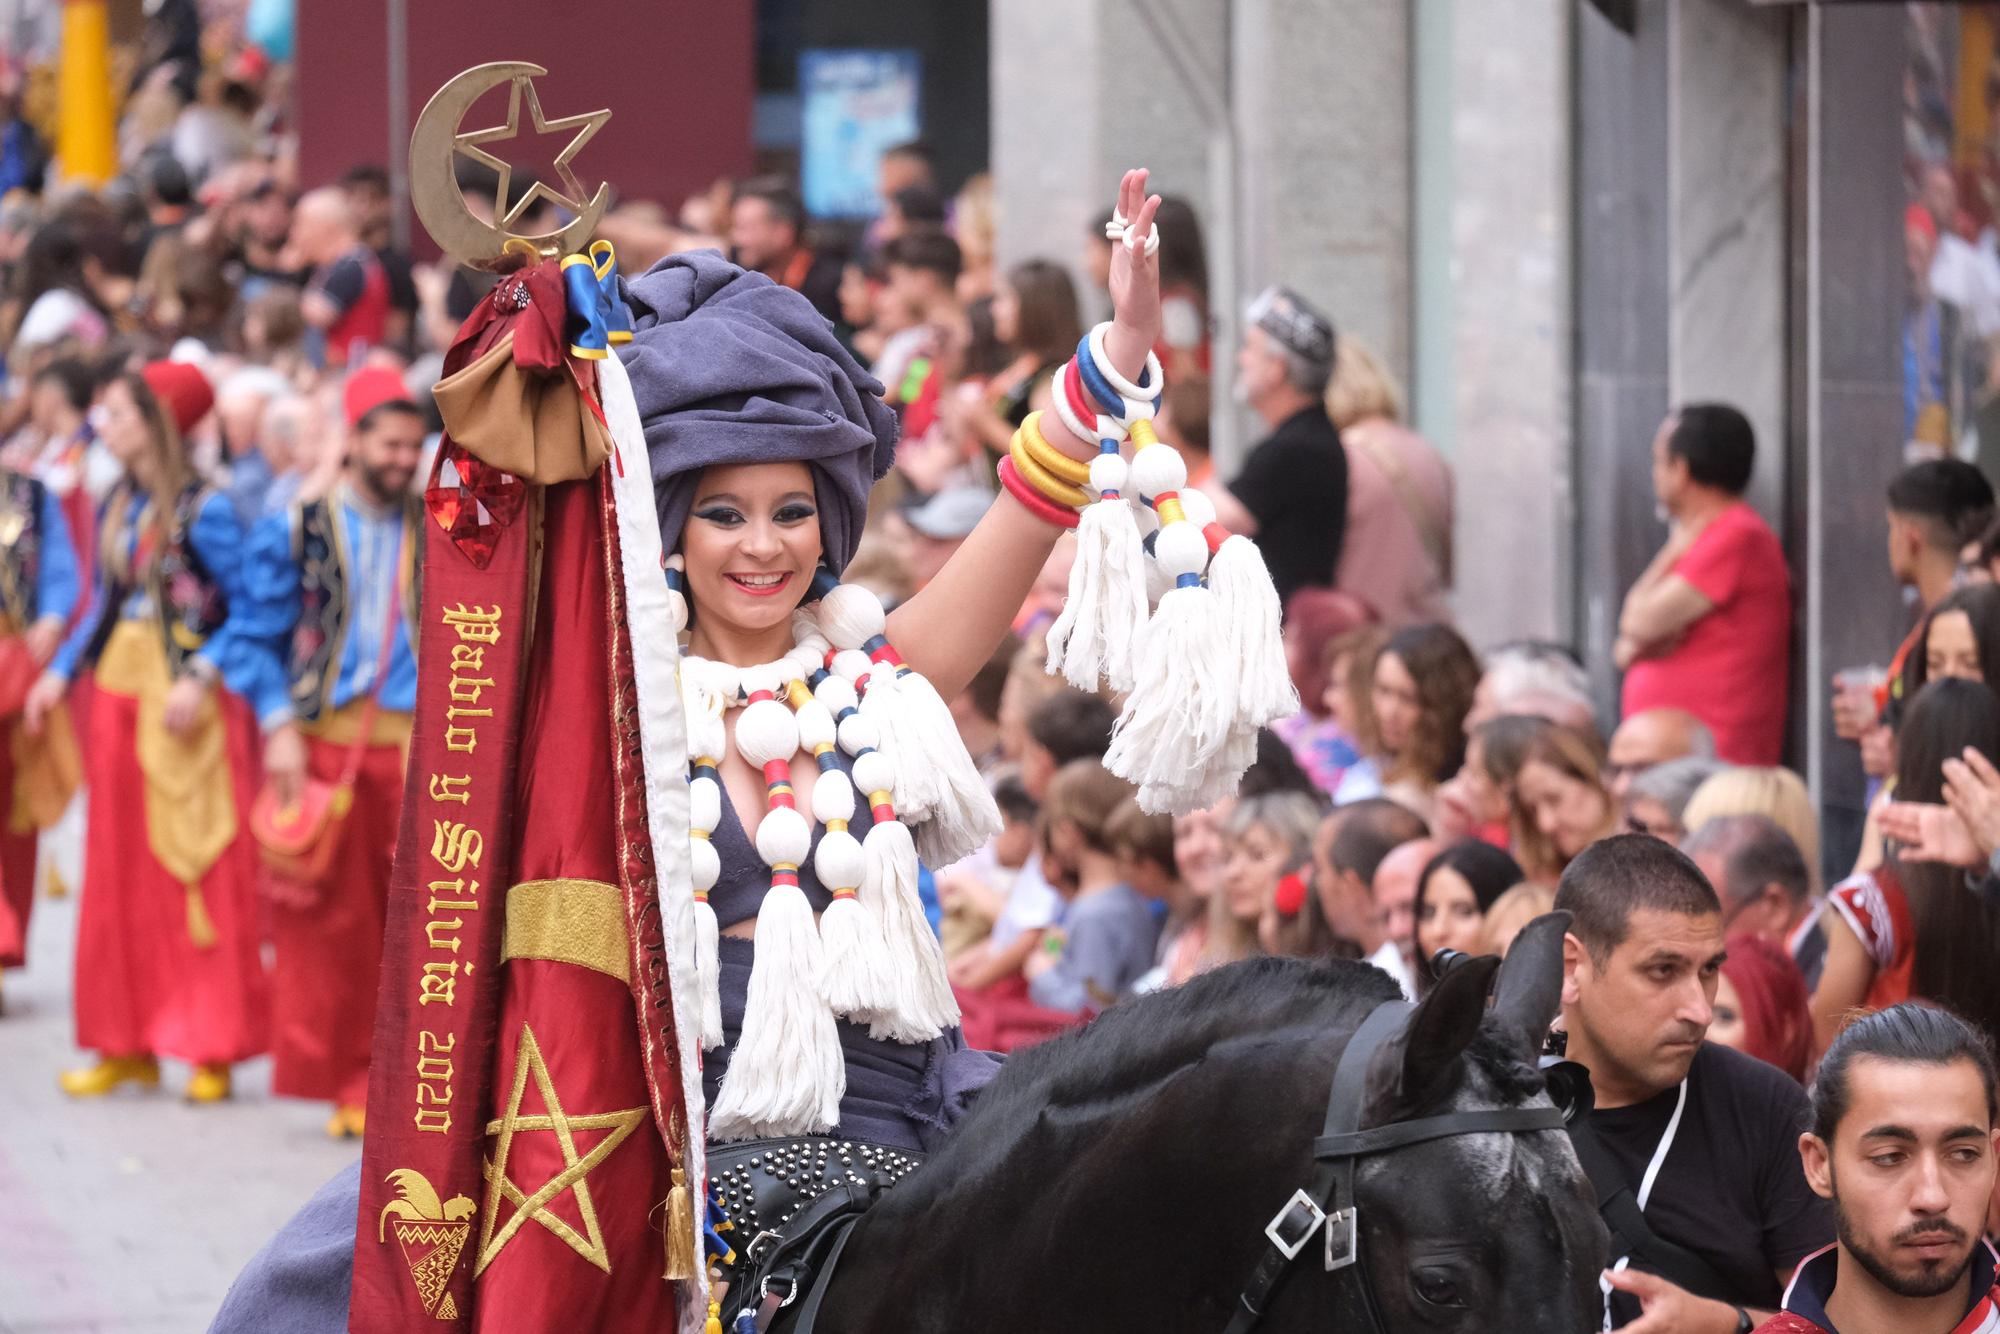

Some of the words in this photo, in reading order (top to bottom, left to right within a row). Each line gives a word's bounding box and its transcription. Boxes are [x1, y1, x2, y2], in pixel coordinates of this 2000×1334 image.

[442, 602, 502, 754] Pablo
[429, 773, 472, 806] y
[419, 819, 483, 1006] Silvia
[414, 1030, 456, 1134] 2020
